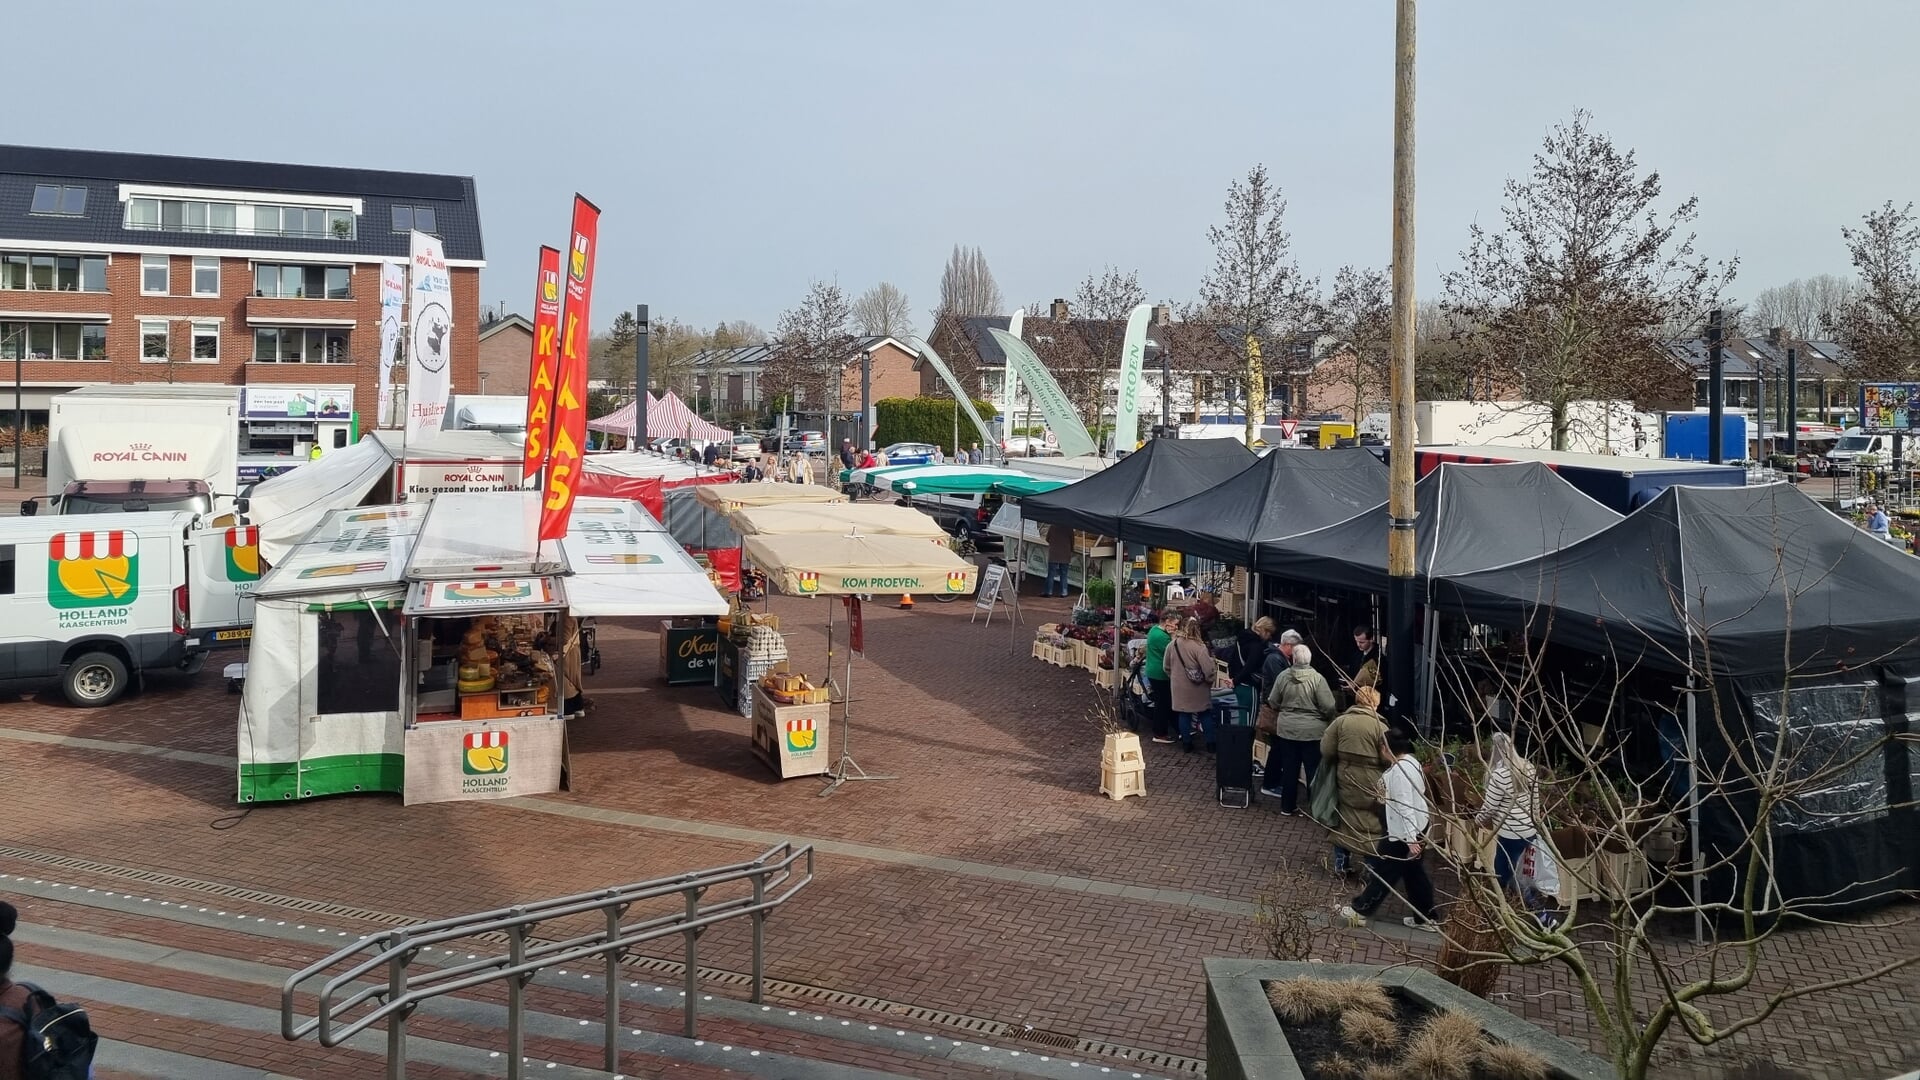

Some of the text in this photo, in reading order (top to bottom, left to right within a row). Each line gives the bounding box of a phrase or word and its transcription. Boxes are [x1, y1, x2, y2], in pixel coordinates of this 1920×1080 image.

[1125, 344, 1140, 413] GROEN
[528, 324, 554, 458] KAAS
[1021, 363, 1056, 416] Chocolaterie
[545, 311, 580, 511] KAAS
[93, 452, 187, 461] ROYAL CANIN
[444, 474, 504, 482] ROYAL CANIN
[409, 485, 429, 493] Kies
[432, 484, 466, 495] gezond
[841, 577, 867, 588] KOM
[59, 608, 129, 620] HOLLAND
[59, 618, 127, 629] KAASCENTRUM
[688, 658, 704, 669] de
[462, 777, 508, 787] HOLLAND
